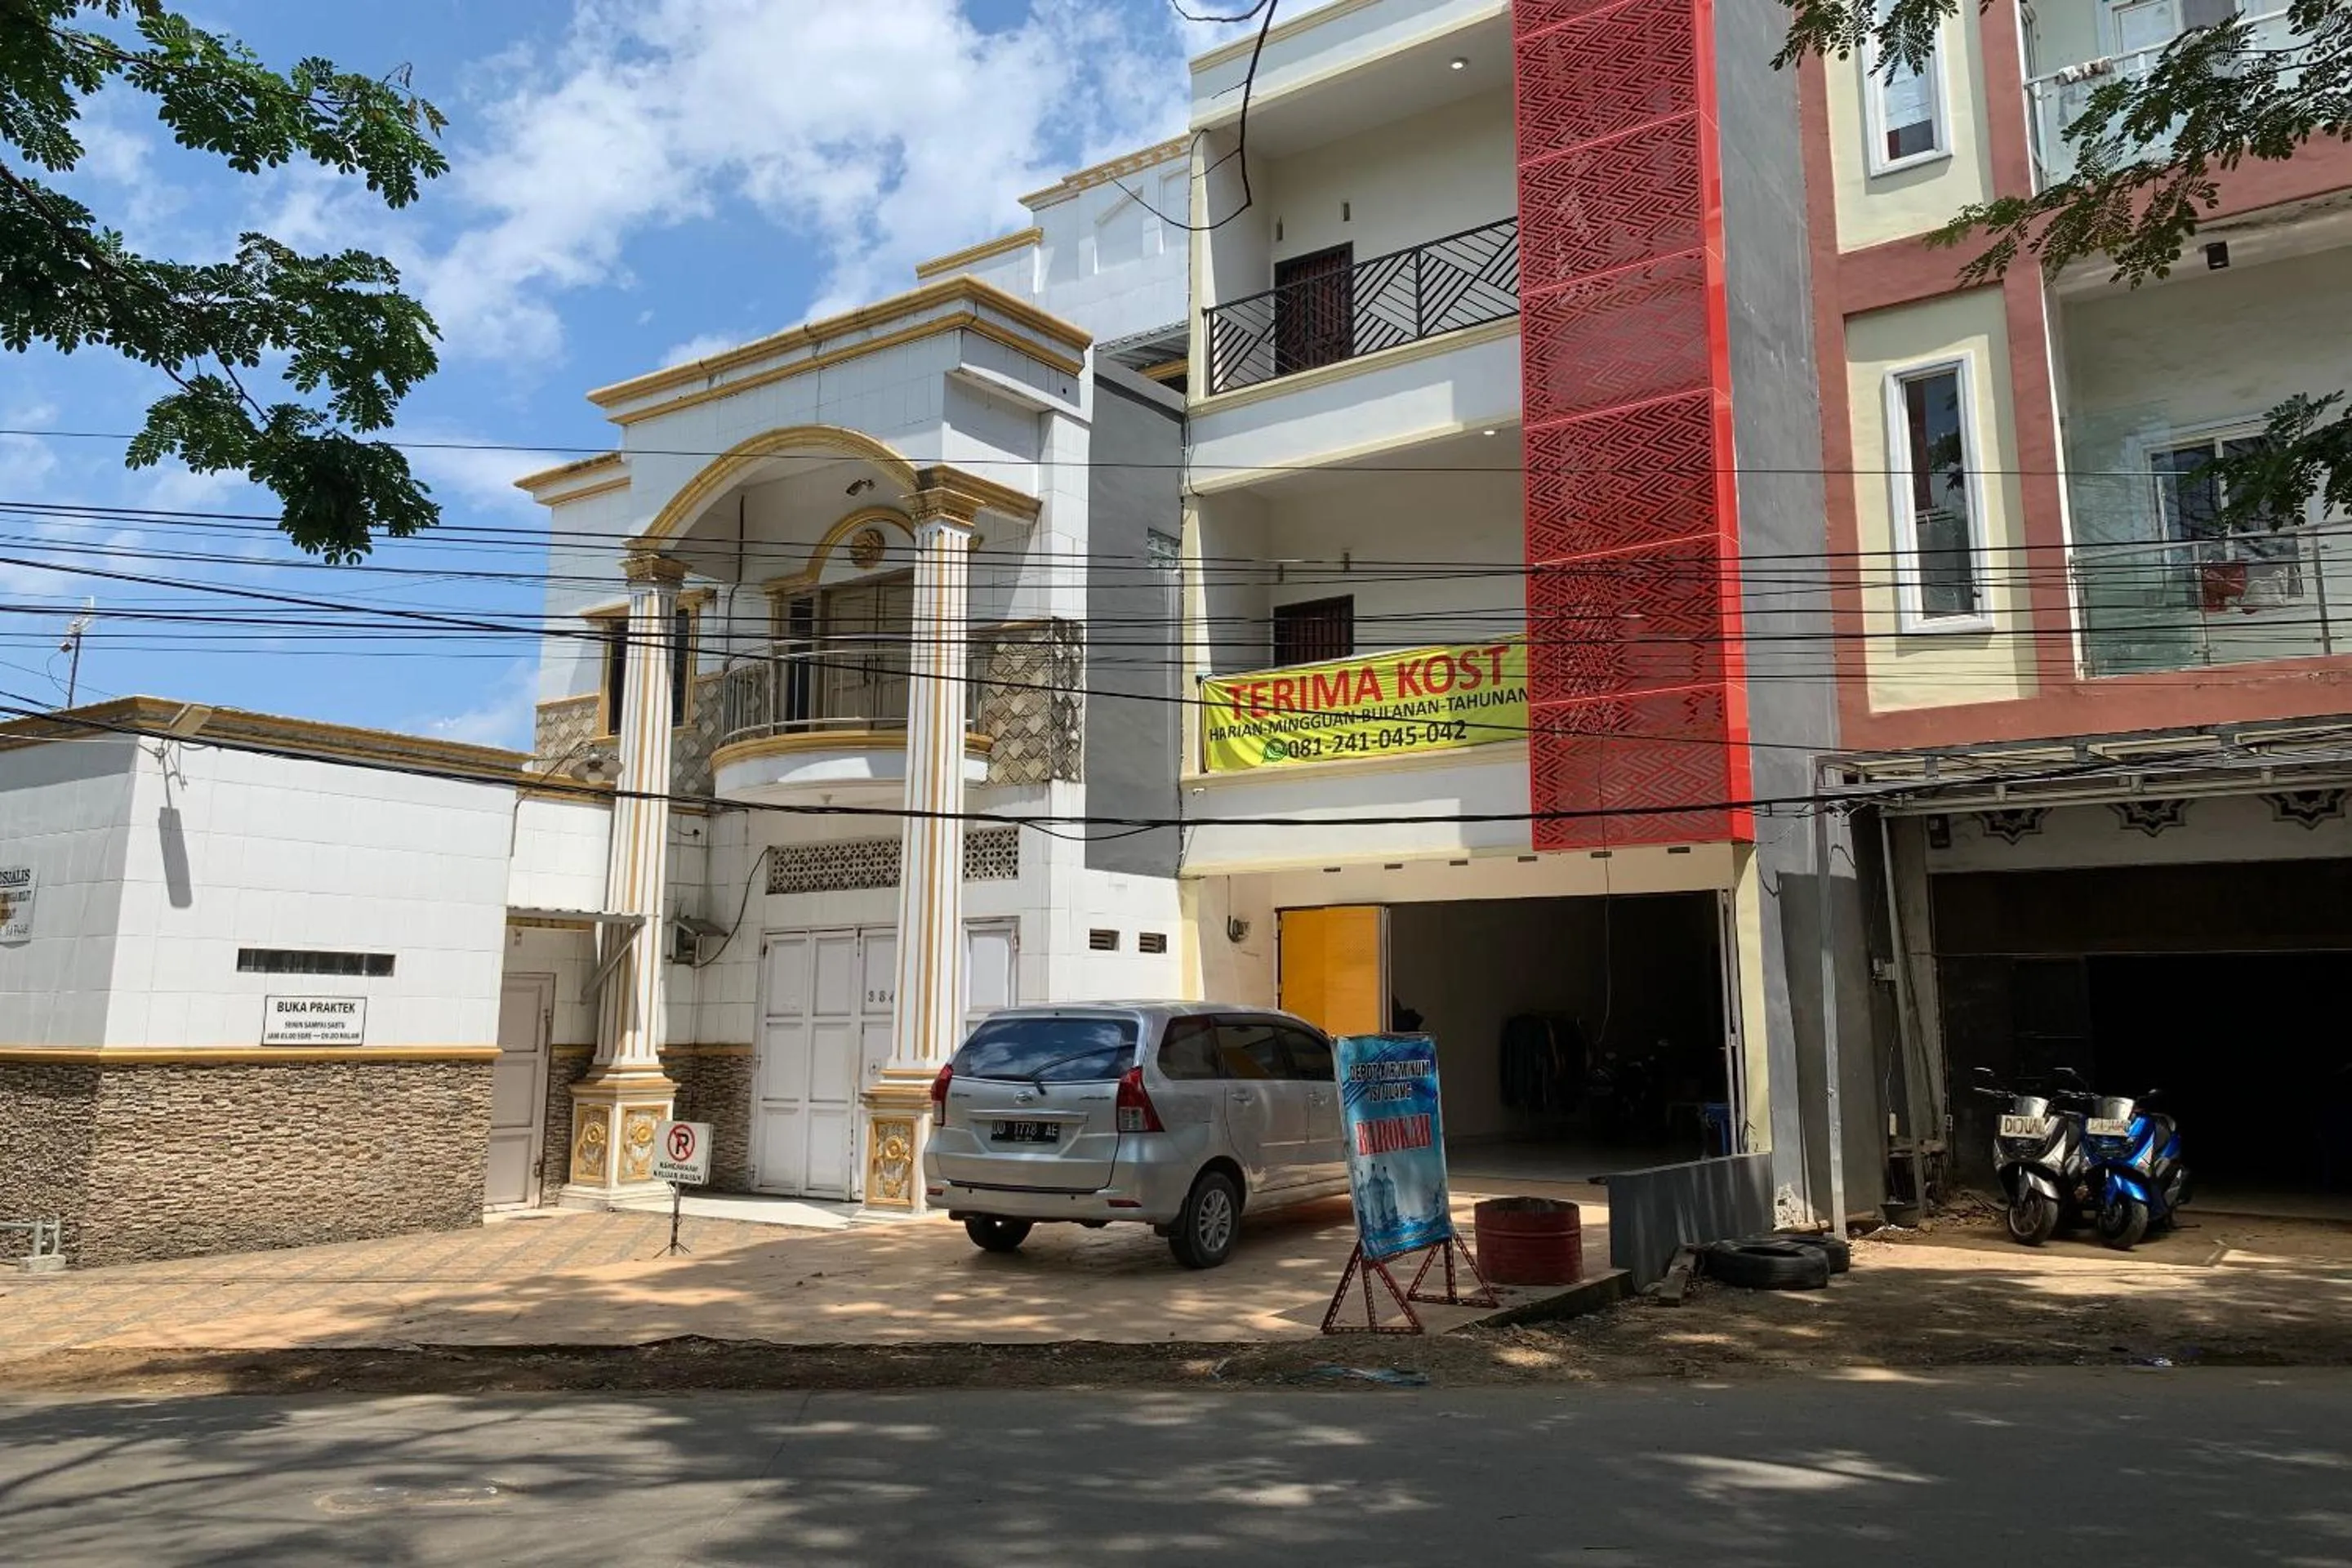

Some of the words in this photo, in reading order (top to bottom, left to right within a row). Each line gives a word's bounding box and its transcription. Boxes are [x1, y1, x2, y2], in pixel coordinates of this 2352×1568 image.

[1225, 666, 1383, 721] TERIMA
[1396, 644, 1510, 699] KOST
[1288, 719, 1468, 760] 081-241-045-042
[277, 1001, 306, 1013] BUKA
[310, 1002, 355, 1013] PRAKTEK
